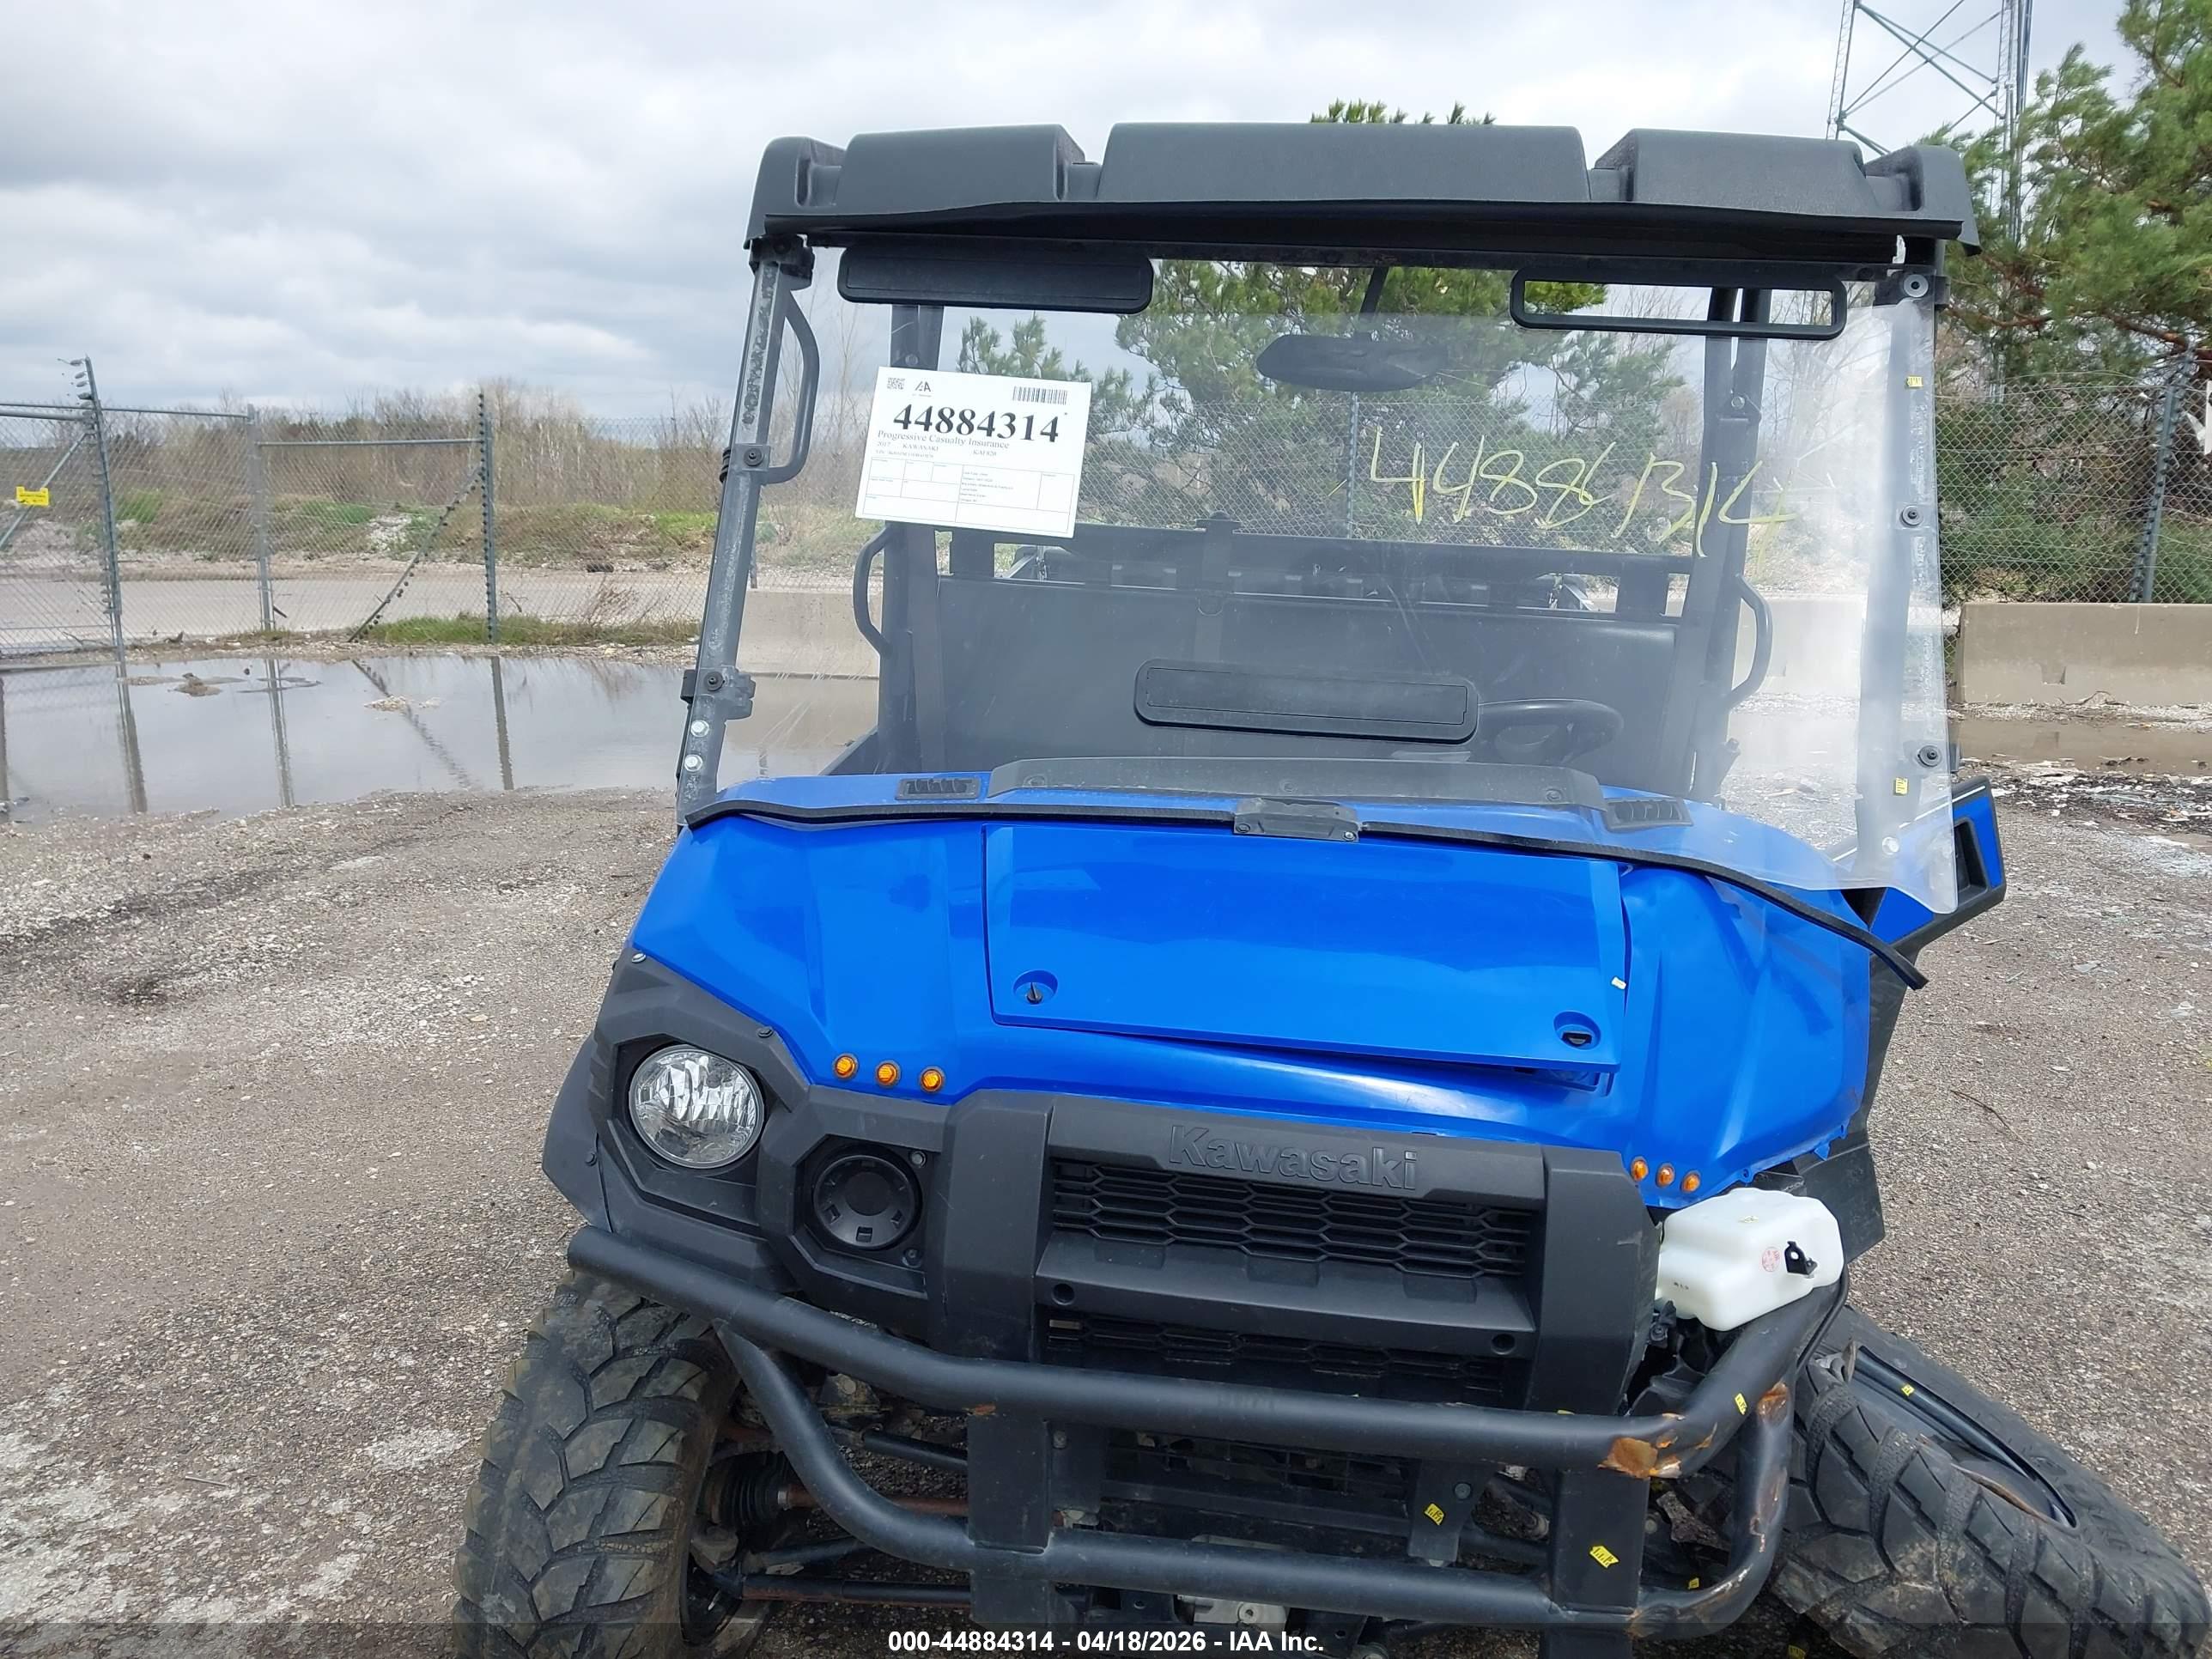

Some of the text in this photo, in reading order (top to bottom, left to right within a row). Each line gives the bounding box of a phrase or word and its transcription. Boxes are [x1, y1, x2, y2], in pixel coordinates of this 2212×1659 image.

[893, 404, 1059, 442] 44884314
[878, 429, 1010, 449] Progressive Casualty Insurance
[902, 443, 939, 452] KAWASAKI
[1168, 1125, 1418, 1190] Kawasaki
